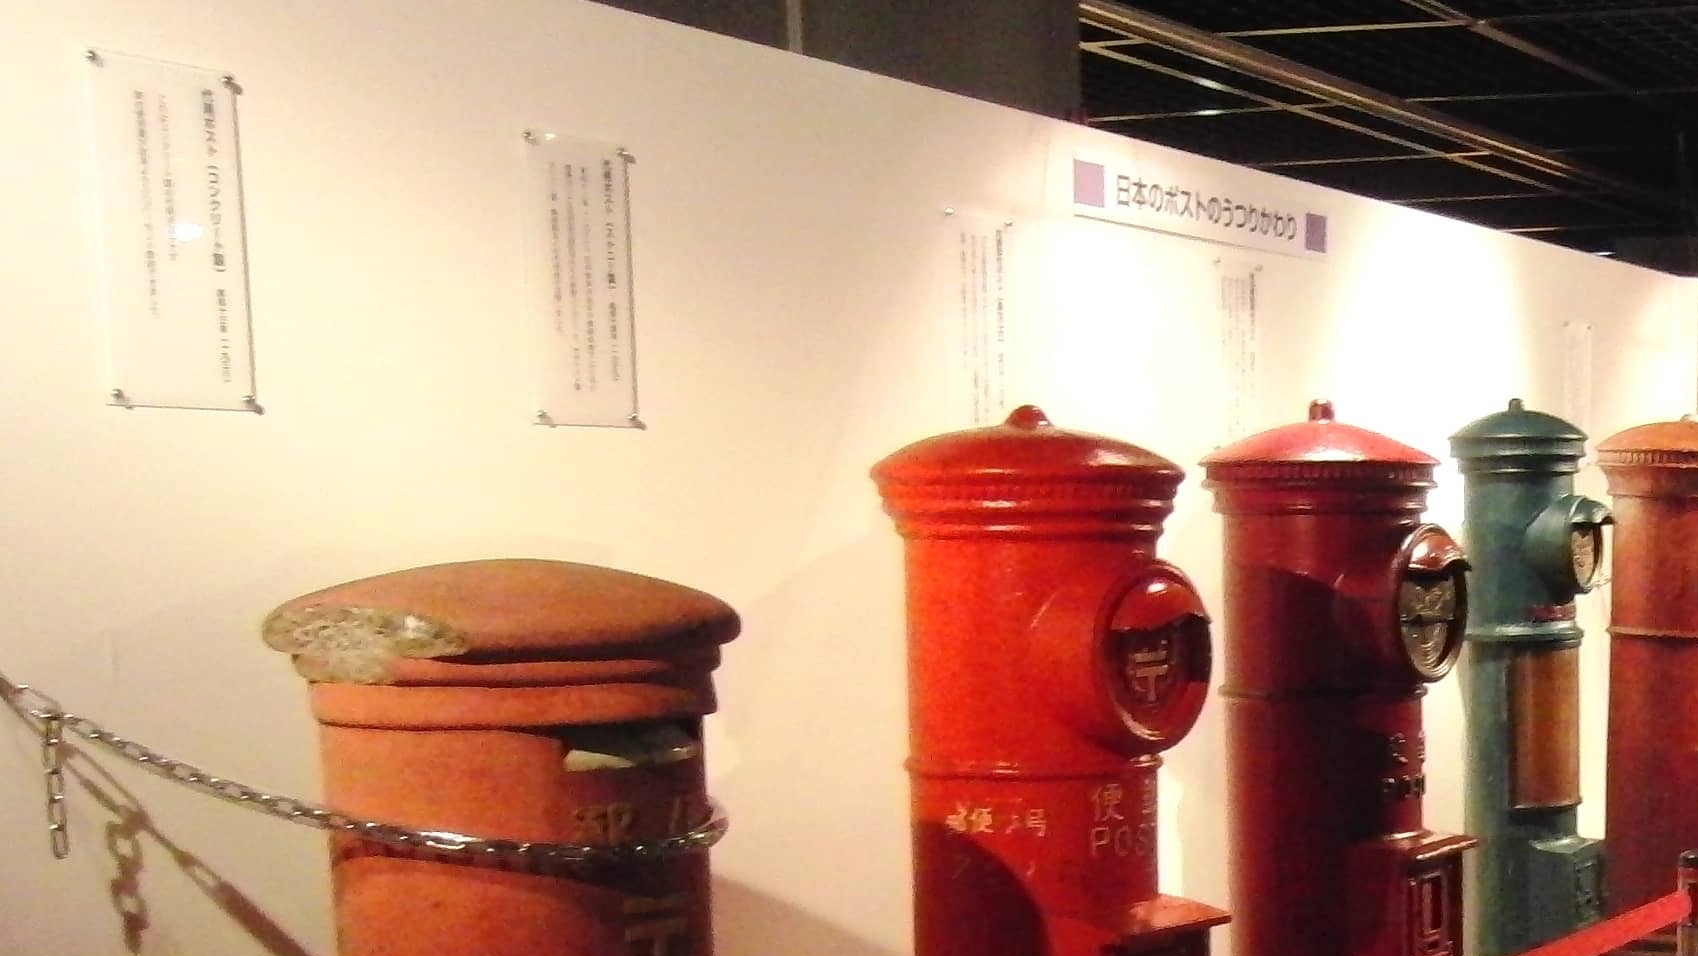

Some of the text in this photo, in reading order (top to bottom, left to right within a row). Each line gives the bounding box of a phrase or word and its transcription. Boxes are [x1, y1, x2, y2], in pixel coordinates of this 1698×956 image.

[1117, 174, 1297, 240] 日本のポストのうつりかわり
[1090, 823, 1157, 857] POS
